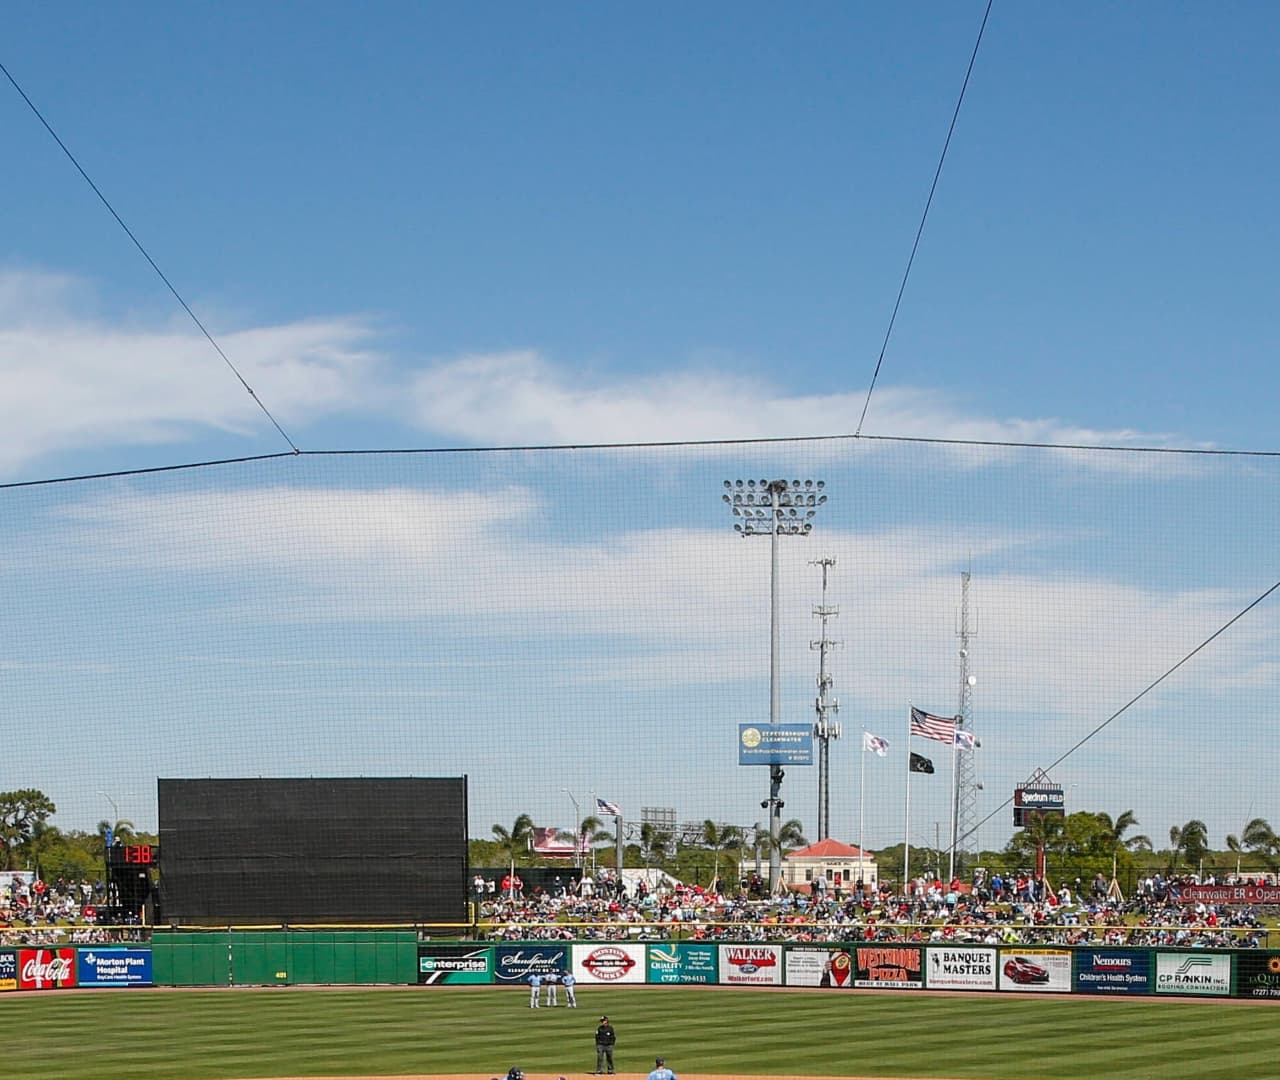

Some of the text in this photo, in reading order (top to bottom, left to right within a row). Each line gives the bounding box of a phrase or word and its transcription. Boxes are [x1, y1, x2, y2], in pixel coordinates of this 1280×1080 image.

[1183, 888, 1232, 900] Clearwater
[1234, 889, 1245, 899] ER
[592, 947, 625, 958] BOSTON
[725, 947, 772, 961] WALKER
[943, 952, 992, 963] BANQUET
[97, 957, 145, 966] Morton Plant
[424, 959, 486, 970] enterprise
[856, 948, 920, 972] WESTSHORE
[1093, 955, 1132, 966] Nemours
[97, 966, 128, 974] Hospital
[650, 962, 682, 970] QUALITY
[943, 965, 991, 975] MASTERS
[591, 969, 626, 980] MARKET
[869, 968, 909, 981] PIZZA
[1107, 974, 1125, 982] Health
[1125, 975, 1147, 983] System
[1159, 974, 1172, 983] CP
[1174, 974, 1212, 984] RANKIN
